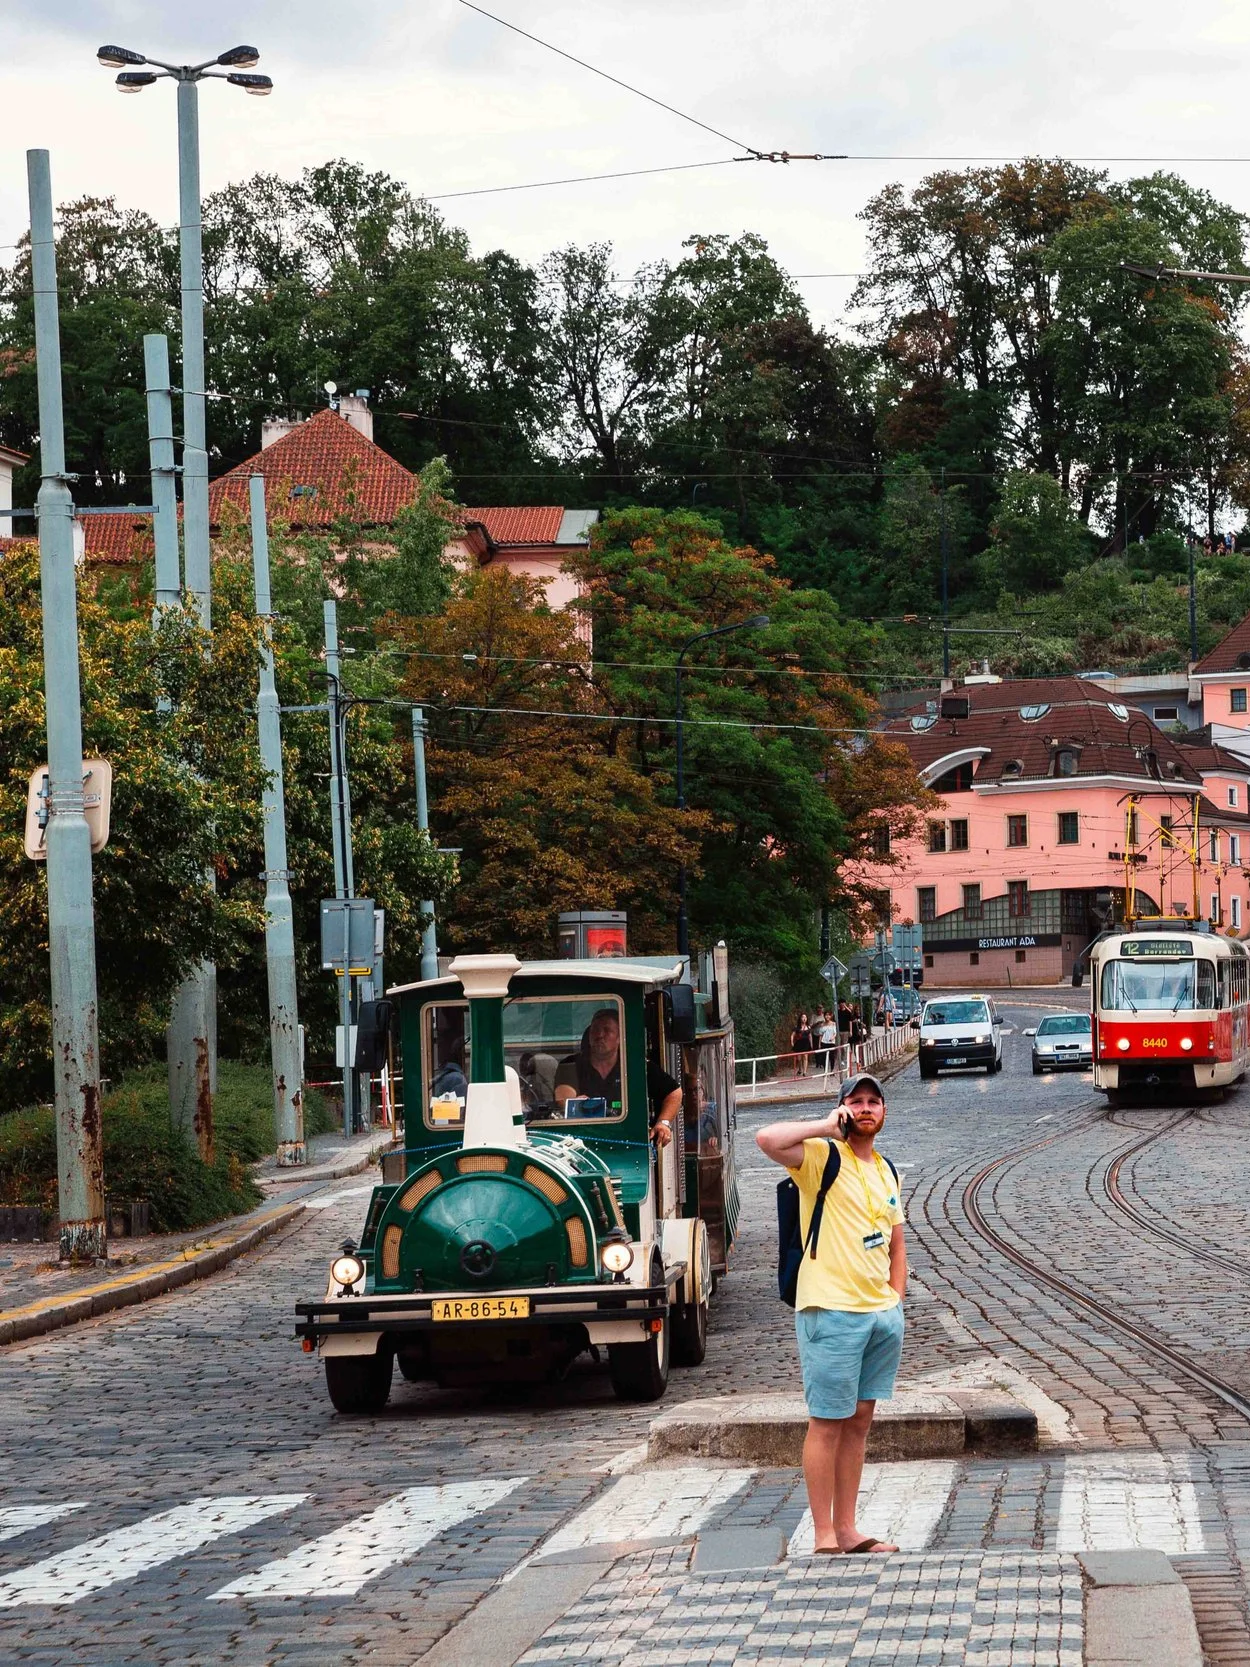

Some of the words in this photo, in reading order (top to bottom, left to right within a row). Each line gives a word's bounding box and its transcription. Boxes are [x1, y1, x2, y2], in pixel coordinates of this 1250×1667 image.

[978, 937, 1017, 948] RESTAURANT
[1019, 936, 1035, 945] ADA
[1124, 942, 1139, 954] 12
[1142, 1038, 1168, 1047] 8440
[443, 1301, 518, 1318] AR-86-54
